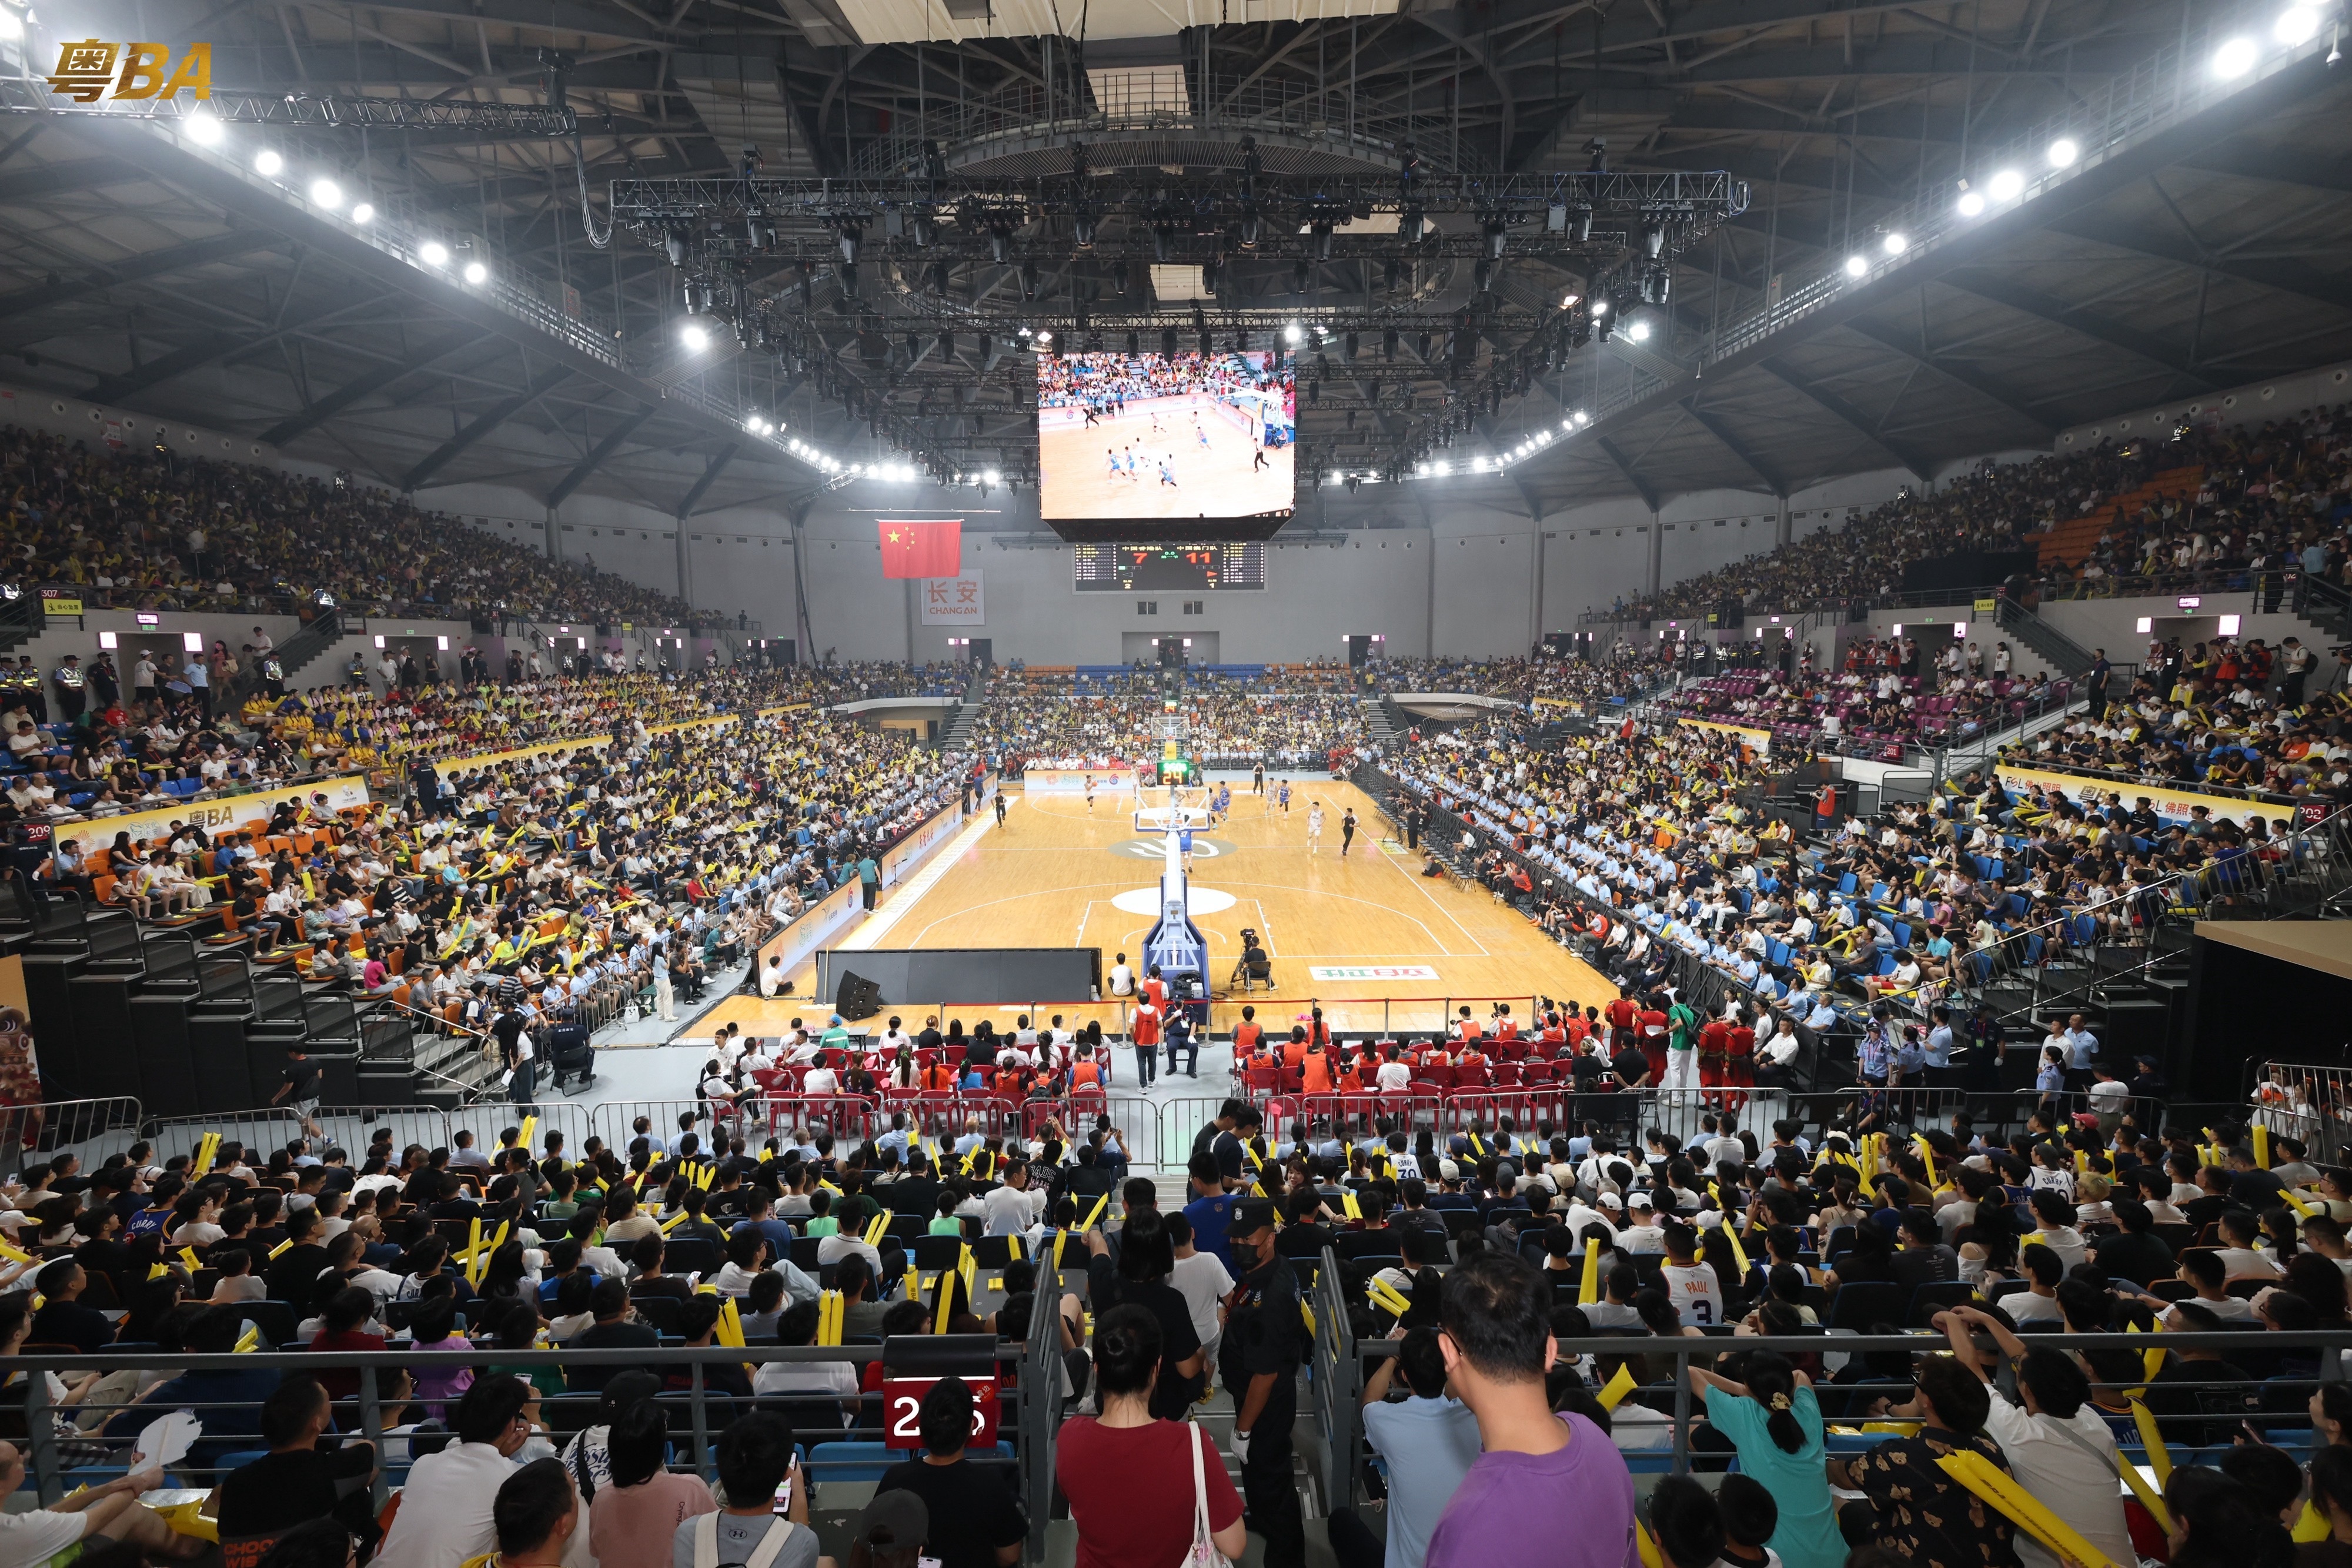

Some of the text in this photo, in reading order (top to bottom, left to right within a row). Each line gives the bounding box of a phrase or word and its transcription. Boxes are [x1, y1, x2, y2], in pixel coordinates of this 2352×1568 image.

[1133, 552, 1211, 564] 7 11
[928, 580, 977, 604] 长安
[1887, 747, 1896, 755] 201
[1163, 771, 1182, 784] 24
[2005, 776, 2023, 790] FSL
[2165, 801, 2214, 821] 佛照光
[28, 825, 50, 839] 209
[2042, 1177, 2064, 1186] CURRY
[132, 1219, 157, 1230] CURRY
[1685, 1281, 1709, 1295] PAUL
[1692, 1300, 1712, 1324] 3
